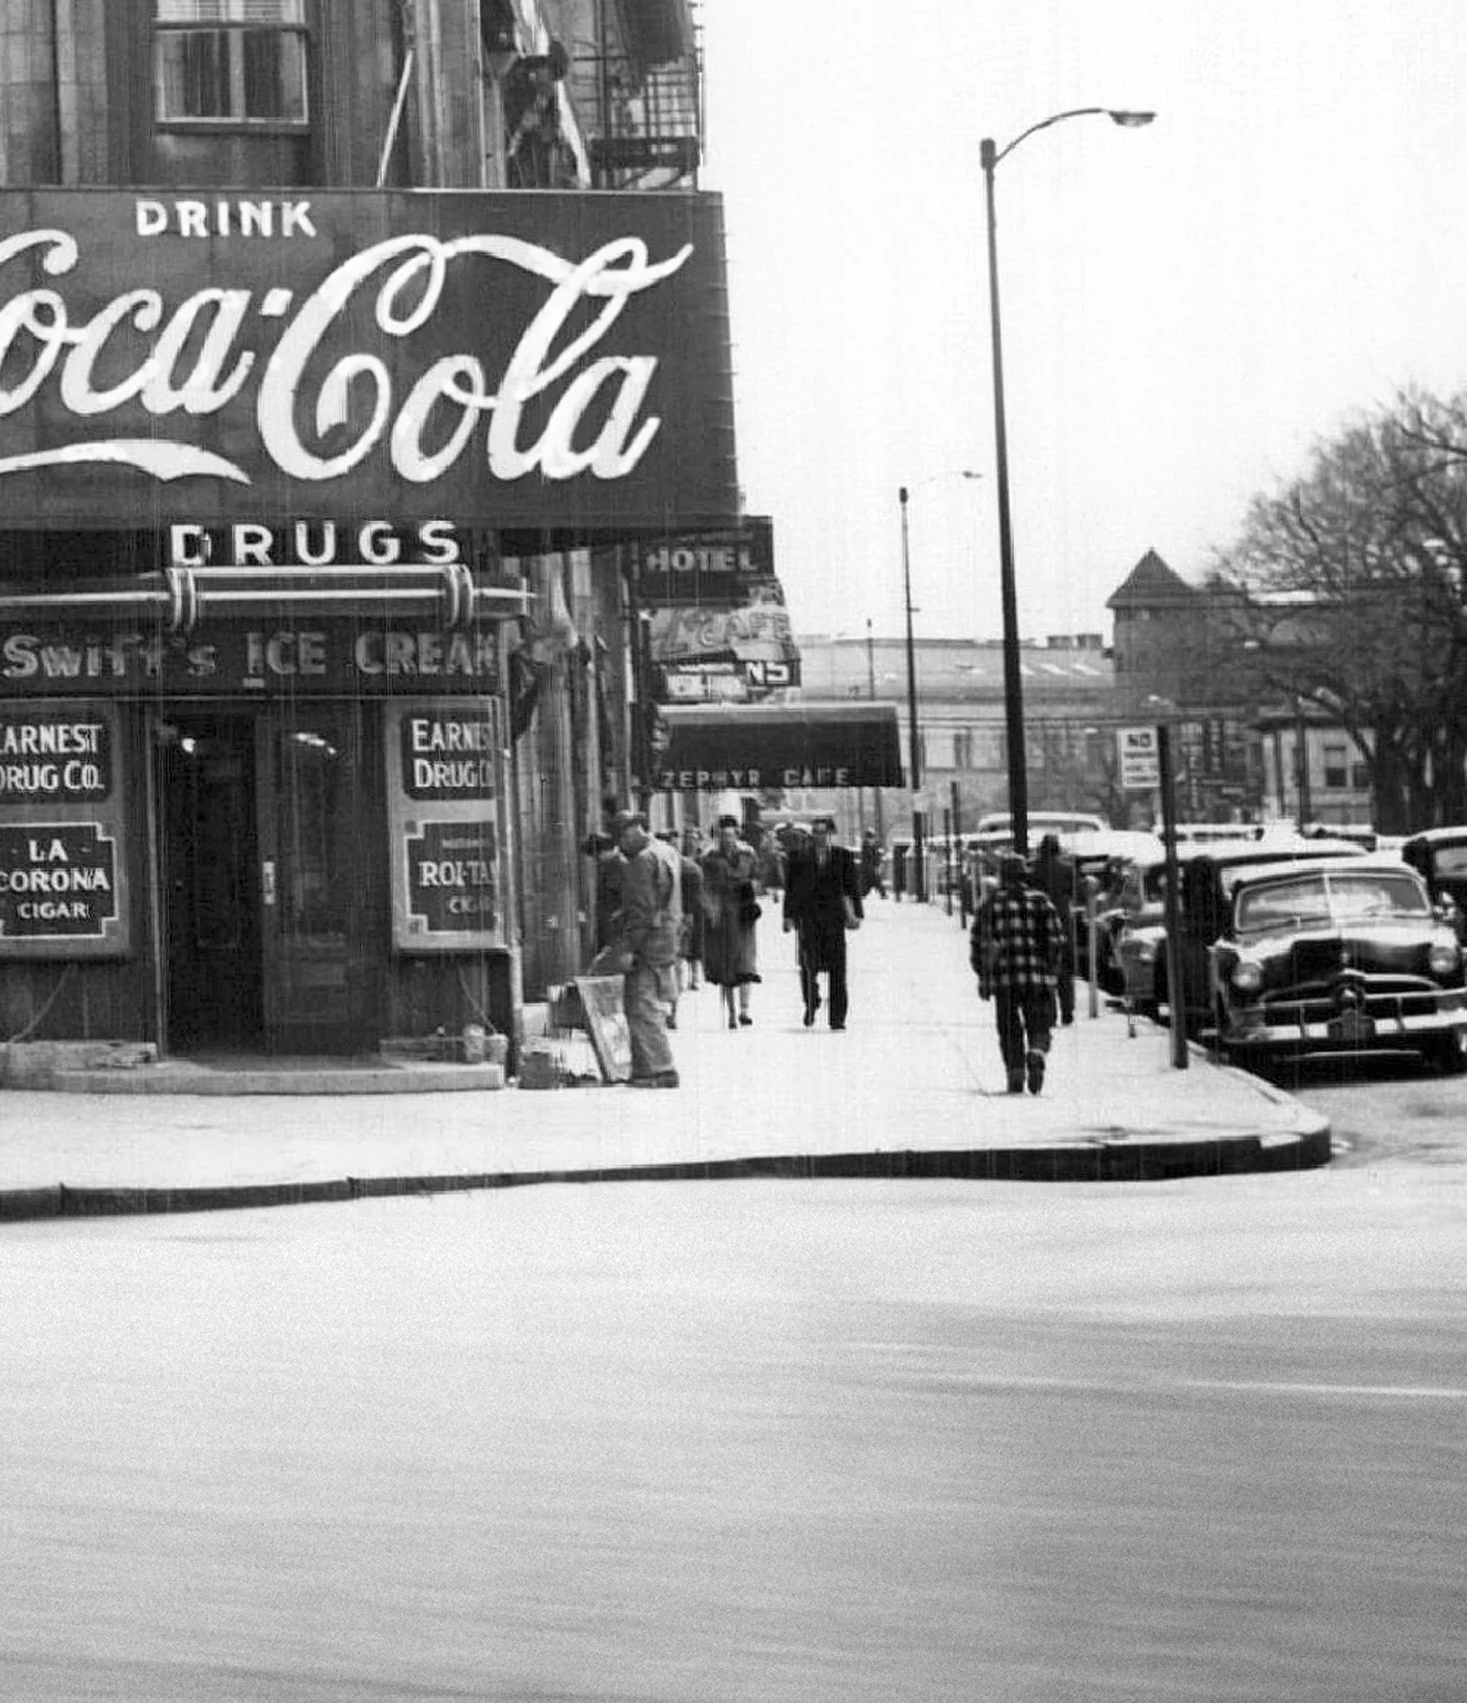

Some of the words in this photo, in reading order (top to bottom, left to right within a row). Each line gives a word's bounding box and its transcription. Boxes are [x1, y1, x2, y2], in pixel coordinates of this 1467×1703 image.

[135, 200, 319, 239] DRINK
[169, 518, 461, 567] DRUGS
[646, 548, 759, 572] HOTEL
[242, 629, 328, 688] ICE
[354, 630, 499, 677] CREAM
[1126, 733, 1152, 748] NO
[413, 757, 477, 788] DRUG
[661, 768, 762, 789] ZEPHYR
[782, 767, 852, 787] CAFE
[28, 838, 69, 863] LA
[18, 901, 90, 919] CIGAR
